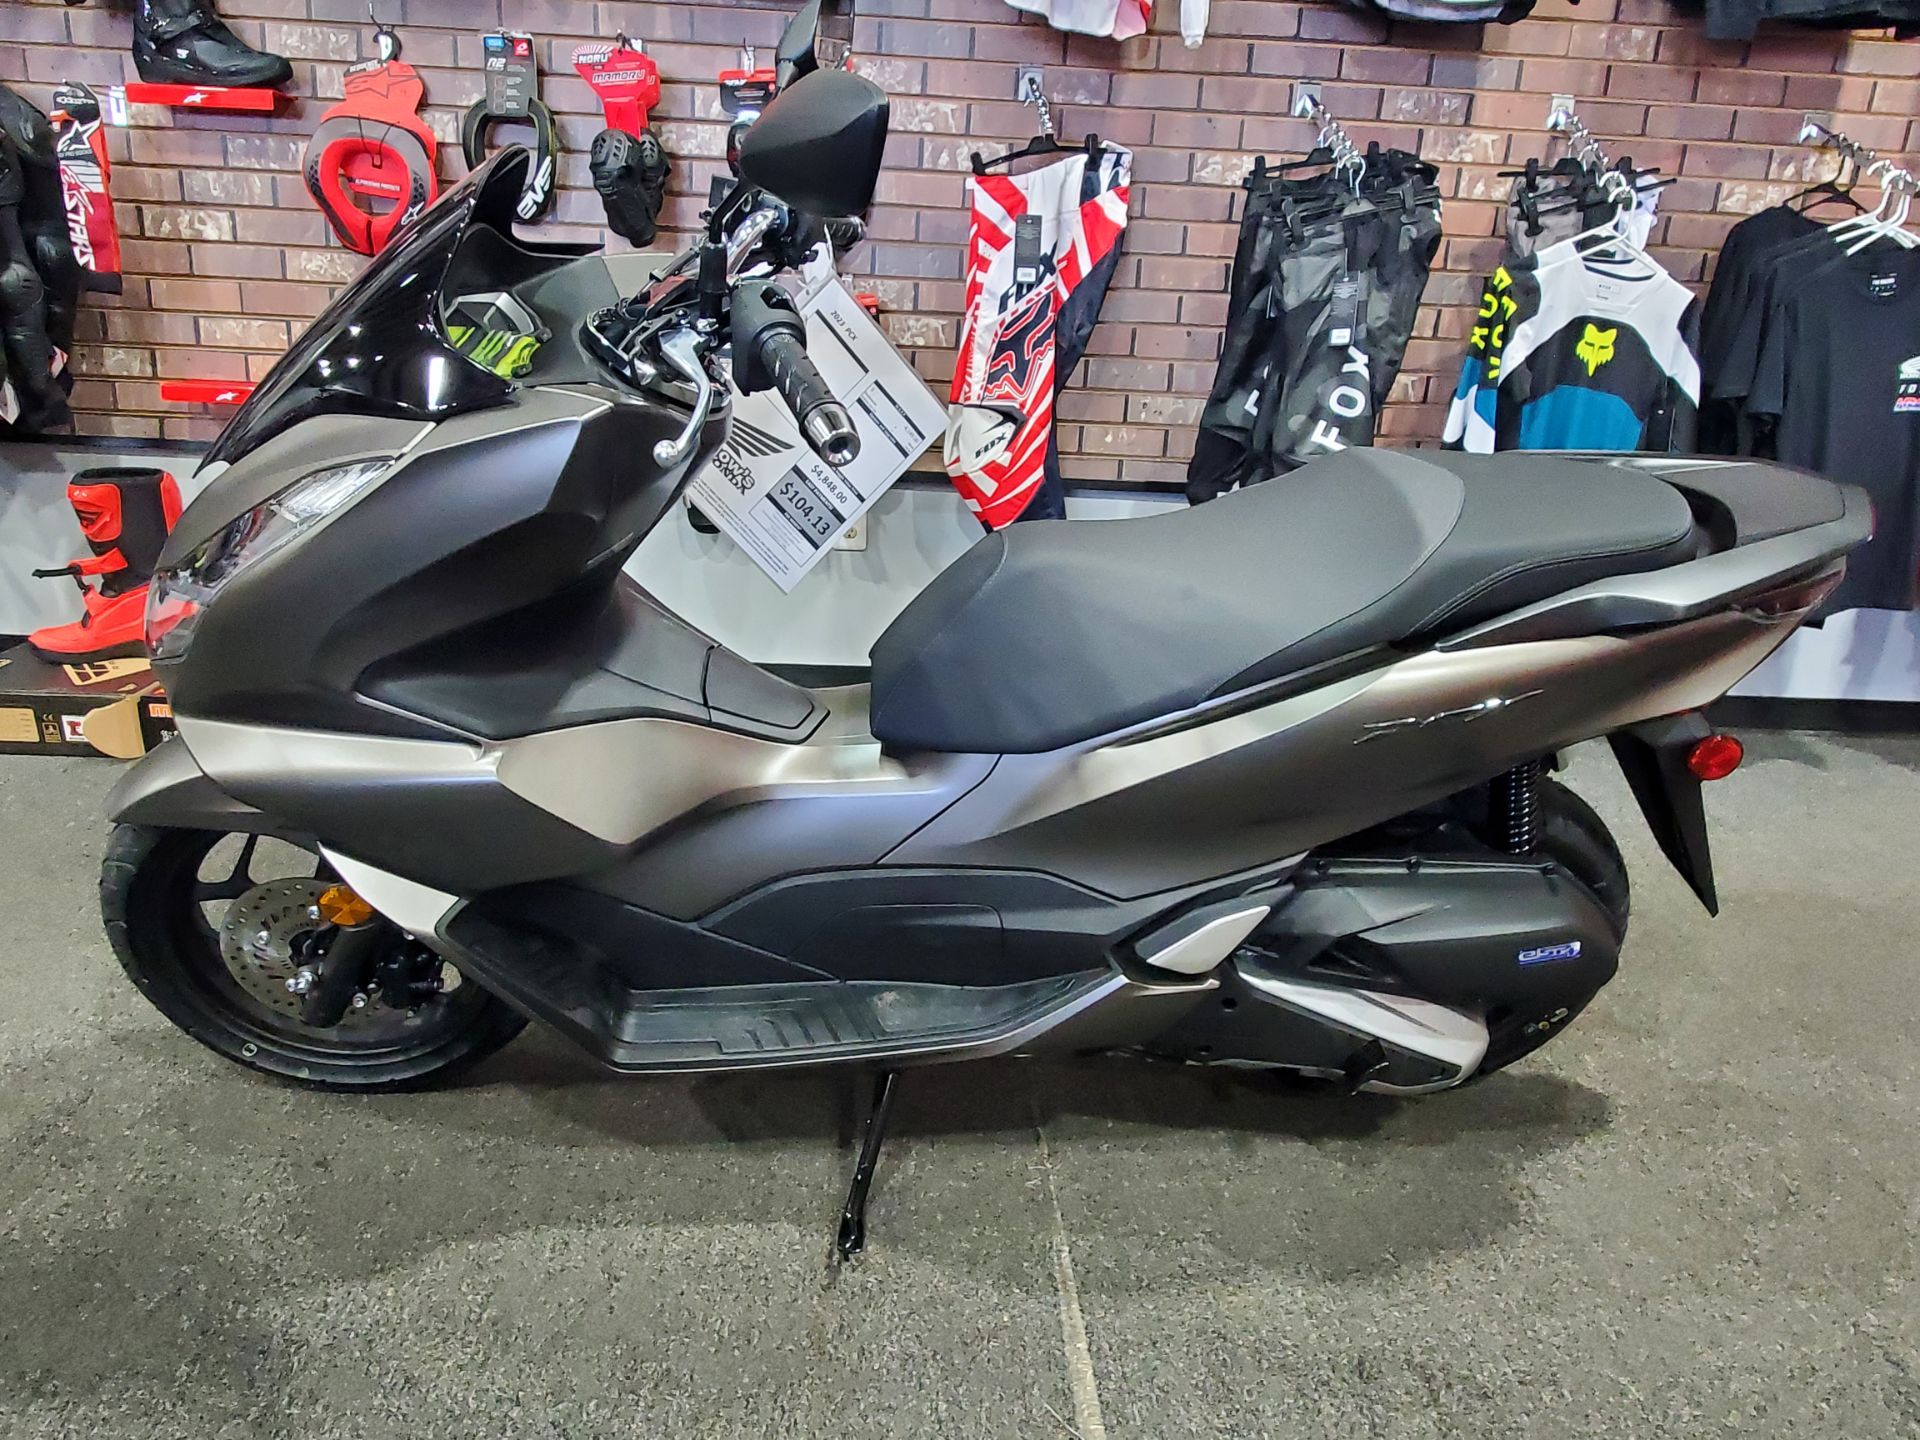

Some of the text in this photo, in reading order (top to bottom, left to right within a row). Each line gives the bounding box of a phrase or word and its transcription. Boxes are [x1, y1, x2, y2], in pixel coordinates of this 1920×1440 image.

[578, 53, 608, 65] NORU
[516, 155, 552, 220] EVS
[831, 311, 857, 340] 2023 PCX
[1310, 345, 1371, 451] FOX
[713, 458, 746, 495] ONDA
[716, 447, 756, 490] ow's
[811, 465, 848, 503] $4,848.00
[780, 483, 830, 536] $104.13
